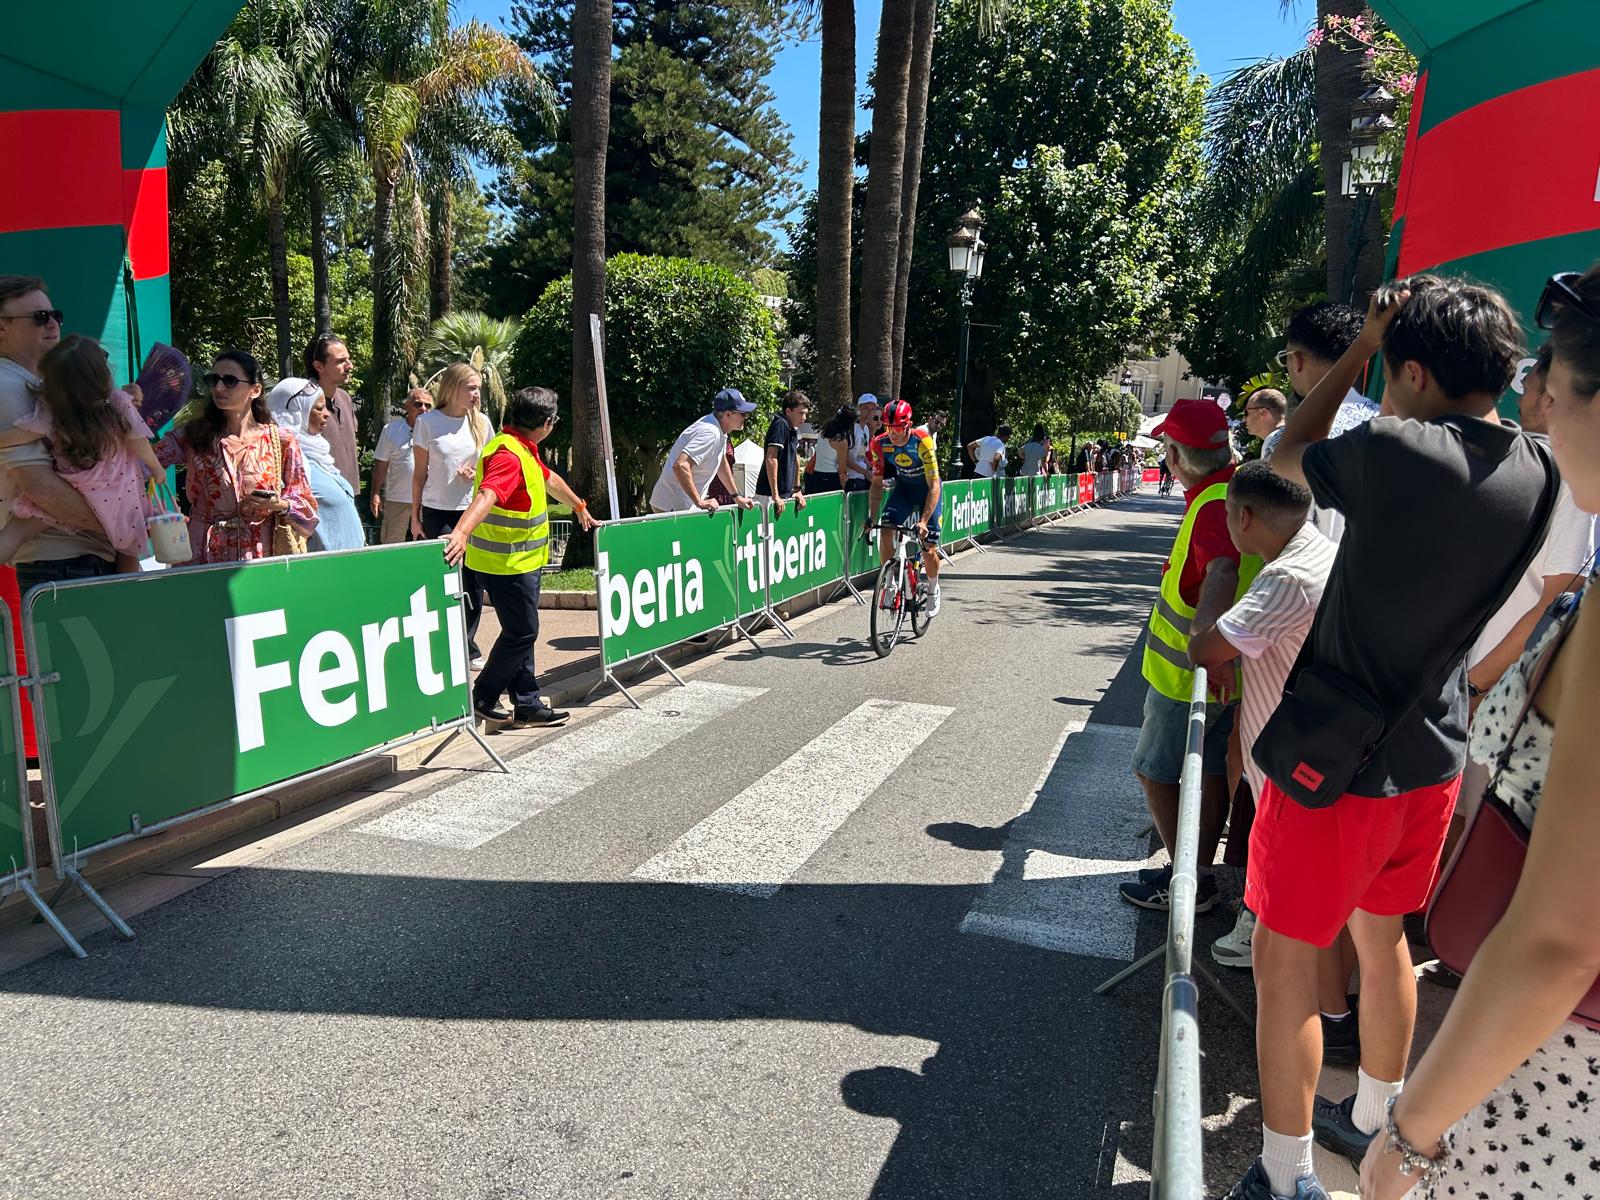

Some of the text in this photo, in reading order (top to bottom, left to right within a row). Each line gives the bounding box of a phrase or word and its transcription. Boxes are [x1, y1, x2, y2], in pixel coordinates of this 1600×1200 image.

[951, 489, 989, 532] Fertiberia
[599, 541, 704, 639] beria
[225, 572, 468, 753] Ferti
